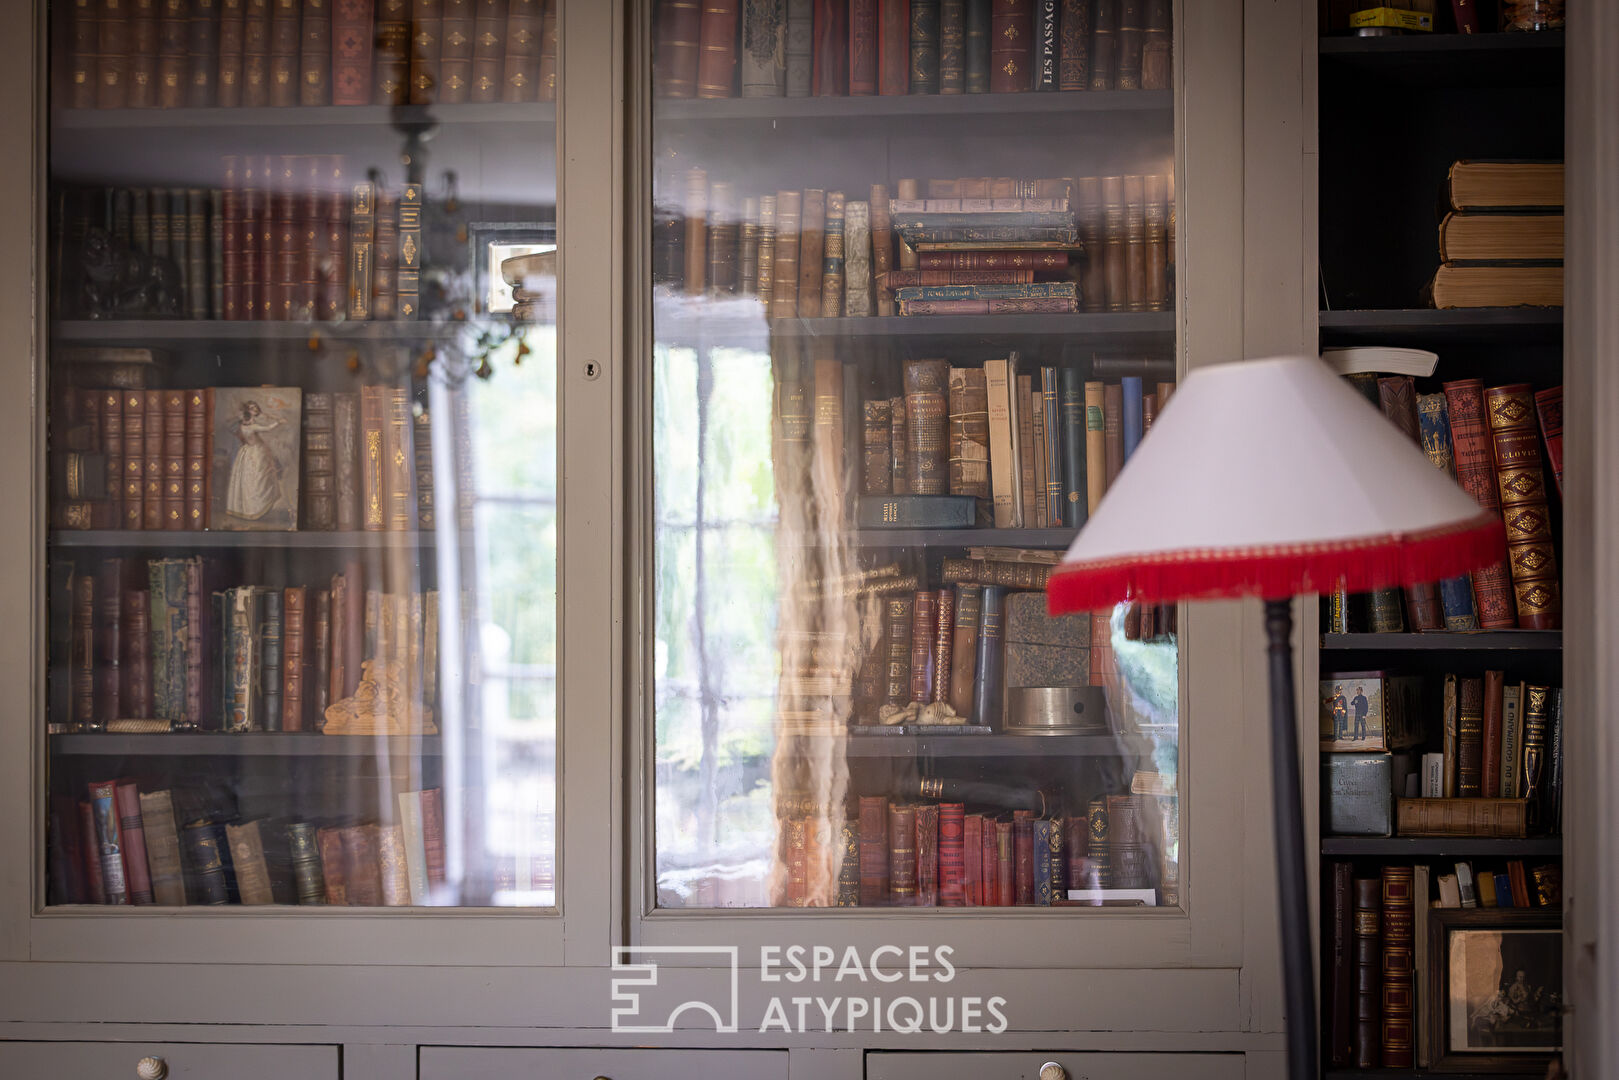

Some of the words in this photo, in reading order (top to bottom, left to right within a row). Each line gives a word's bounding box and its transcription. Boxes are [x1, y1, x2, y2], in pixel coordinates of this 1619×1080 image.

[1044, 0, 1055, 55] PASSAG
[1043, 59, 1053, 84] LES
[1505, 712, 1515, 762] GOURMAND
[1505, 764, 1513, 778] DU
